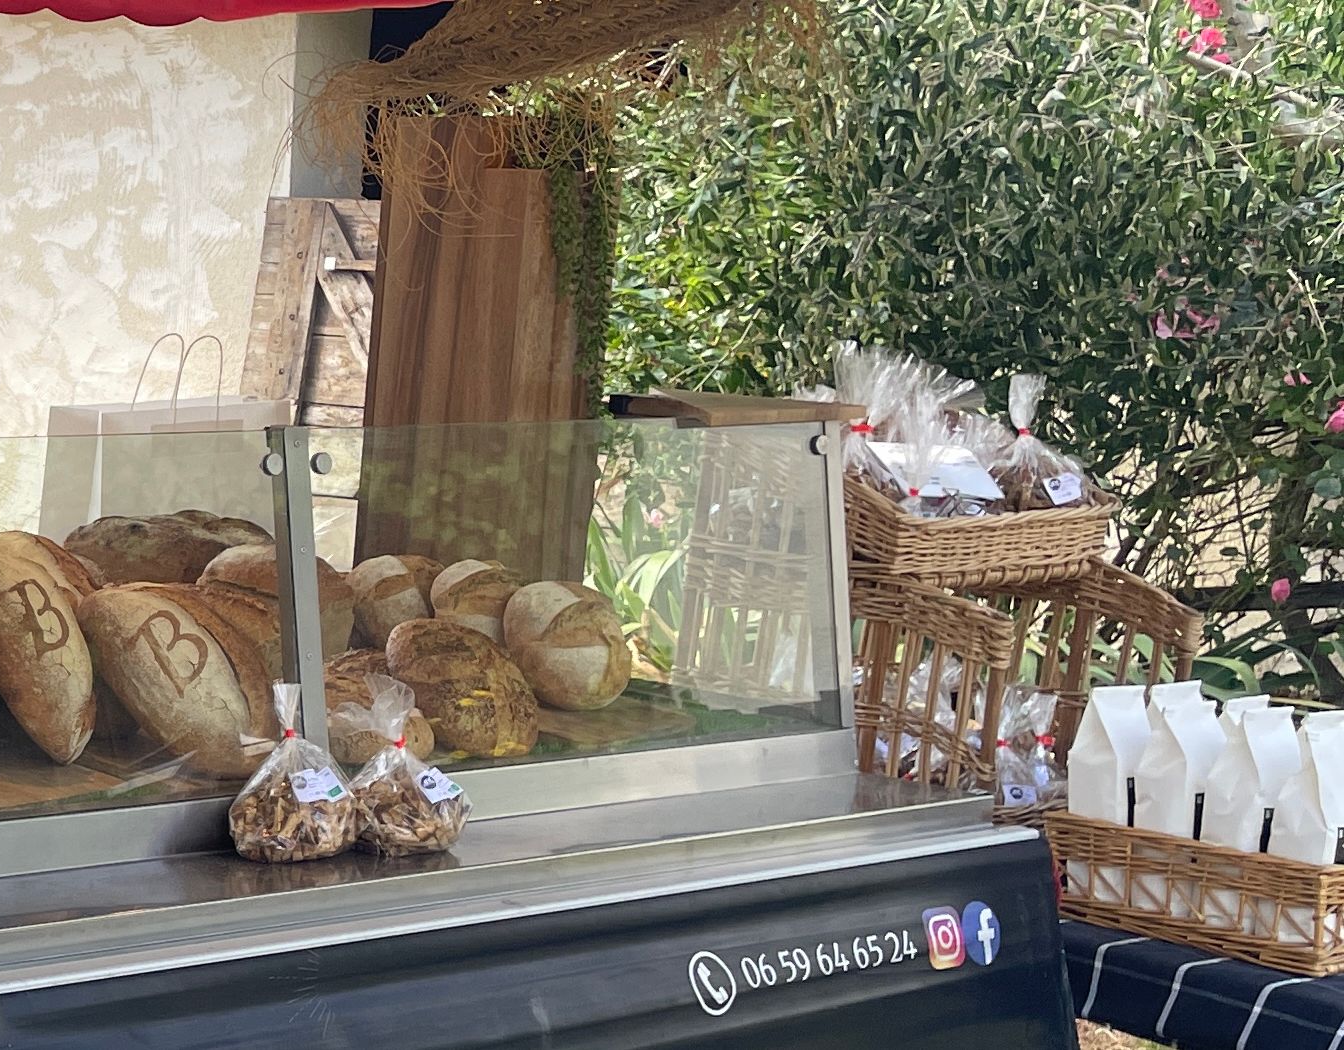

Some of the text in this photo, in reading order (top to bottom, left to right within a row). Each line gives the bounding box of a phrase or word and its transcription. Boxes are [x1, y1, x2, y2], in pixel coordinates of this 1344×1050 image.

[9, 579, 69, 659] B
[123, 610, 208, 699] B
[741, 930, 918, 989] 06 59 64 65 24
